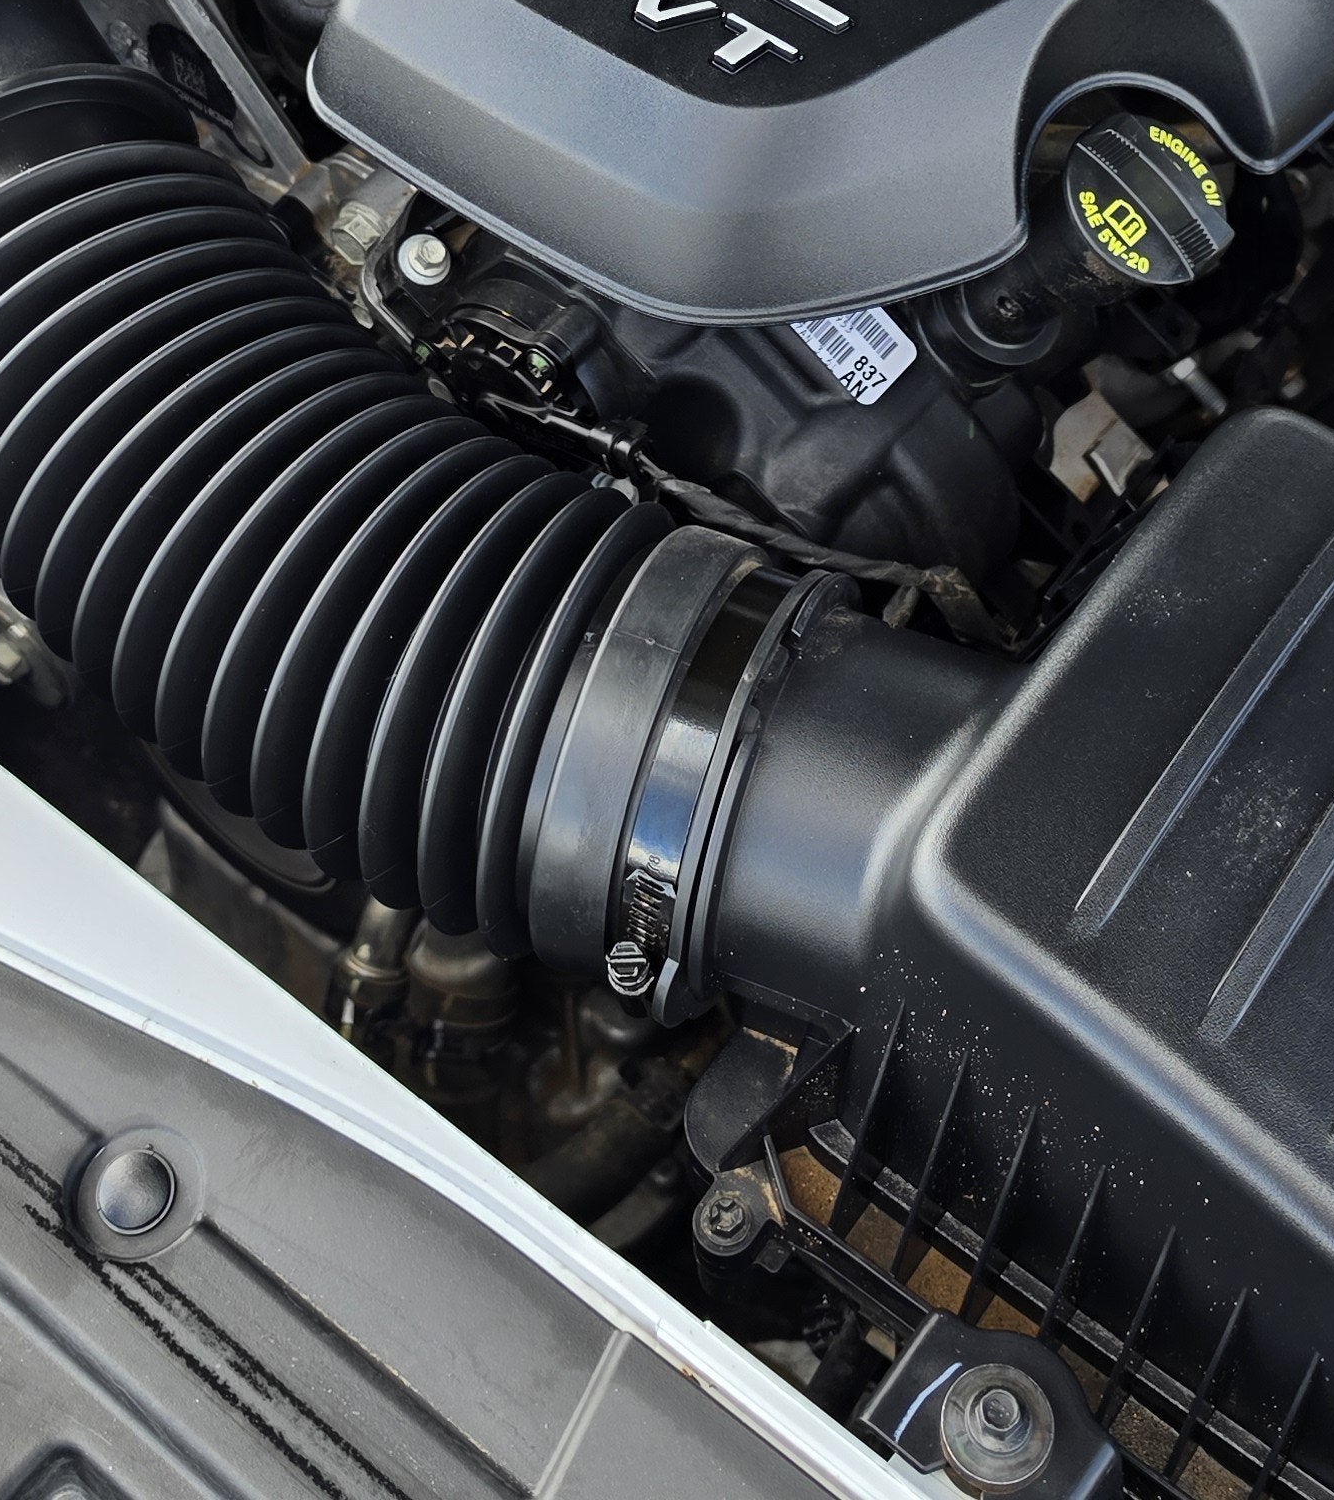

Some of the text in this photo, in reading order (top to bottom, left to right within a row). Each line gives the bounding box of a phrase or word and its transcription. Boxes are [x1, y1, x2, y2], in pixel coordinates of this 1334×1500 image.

[1149, 125, 1222, 207] ENGINE OIL
[1079, 191, 1150, 274] SAE 5W-20
[840, 370, 869, 399] AN
[854, 355, 887, 388] 837
